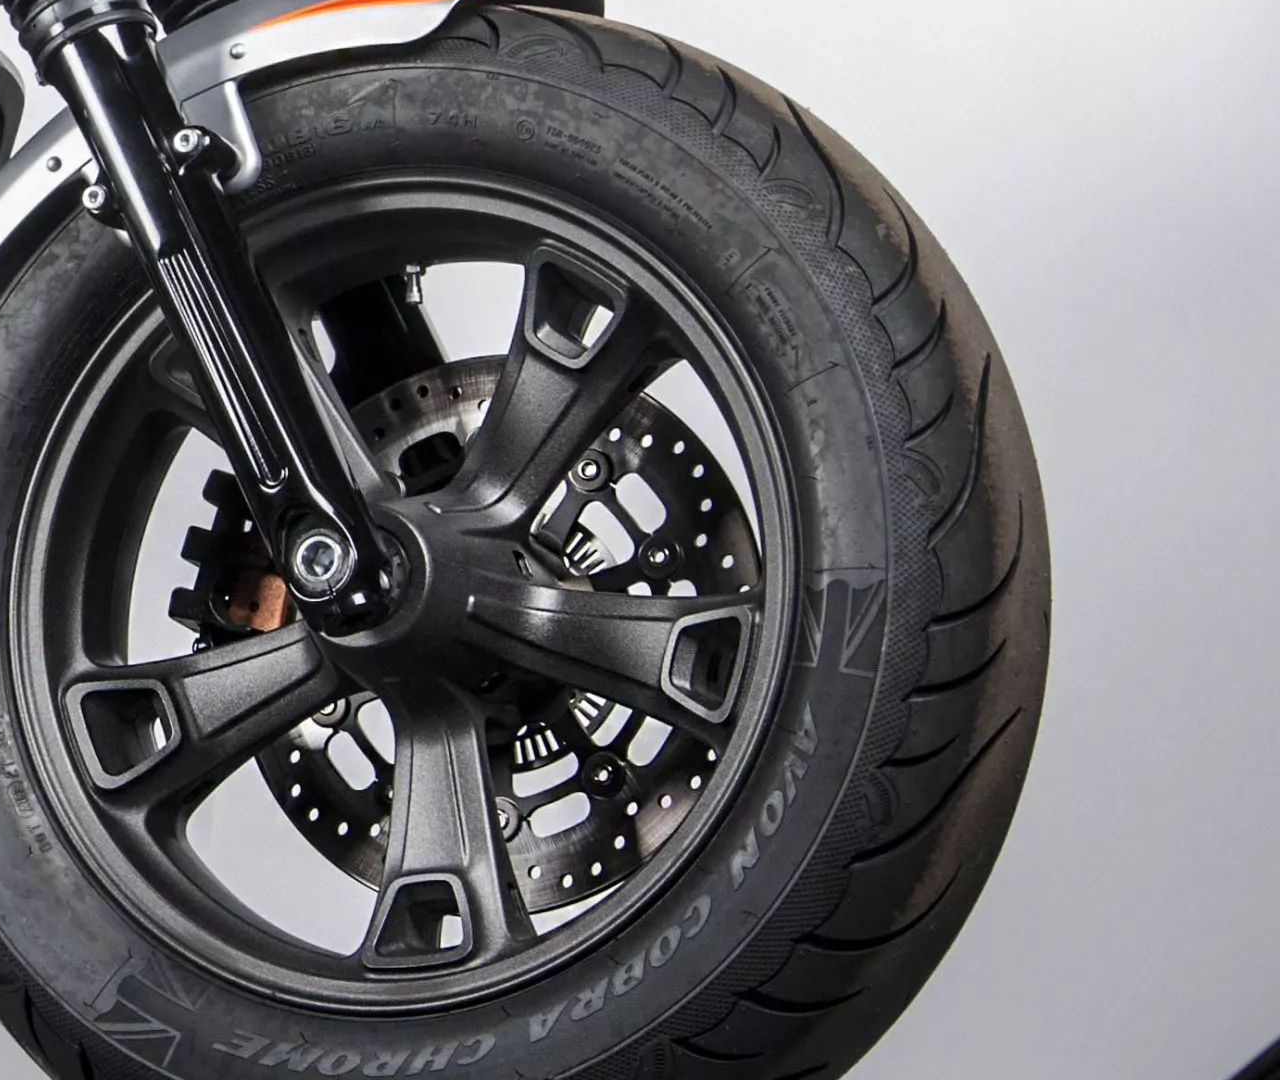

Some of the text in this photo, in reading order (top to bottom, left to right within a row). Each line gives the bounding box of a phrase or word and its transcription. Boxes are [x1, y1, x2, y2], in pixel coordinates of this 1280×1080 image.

[730, 701, 818, 890] AVON
[529, 893, 713, 1043] COBRA
[212, 1028, 498, 1078] CHROME
